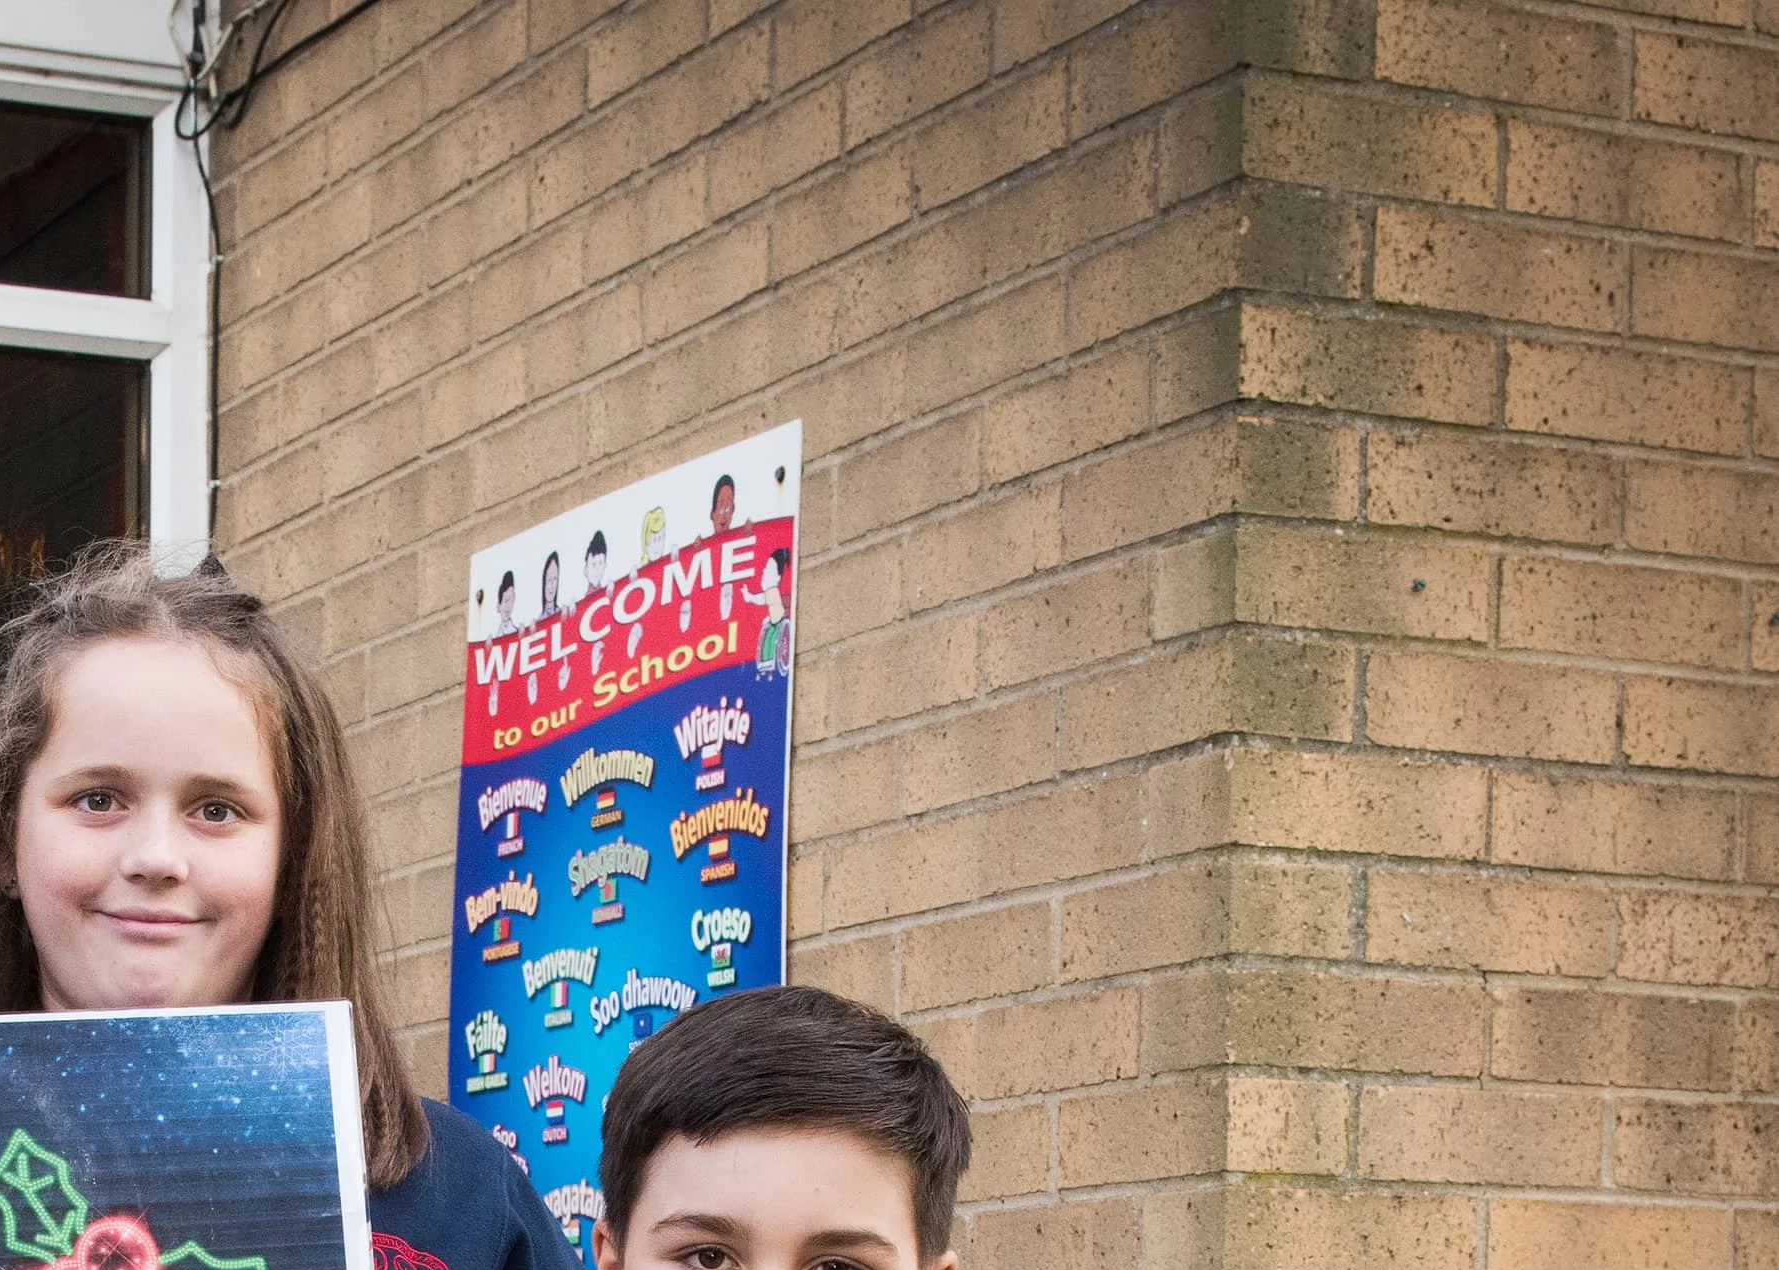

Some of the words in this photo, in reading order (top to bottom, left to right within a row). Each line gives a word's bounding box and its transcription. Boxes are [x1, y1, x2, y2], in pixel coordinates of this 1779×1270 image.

[475, 536, 757, 685] WELCOME
[493, 722, 522, 750] to
[530, 699, 582, 737] our
[593, 621, 739, 709] School
[674, 697, 751, 760] Witajcie
[560, 748, 655, 807] Willkommen
[696, 770, 725, 790] POLISH
[478, 779, 547, 831] Bienvenue
[591, 810, 623, 829] GERMAN
[670, 787, 769, 860] Bienvenidos
[568, 836, 650, 897] Shagatom
[701, 862, 735, 883] SPANISH
[465, 871, 538, 933] Bem-vindo
[692, 907, 752, 951] Croeso
[522, 947, 599, 998] Benvenuti
[707, 968, 736, 987] WELSH
[465, 1010, 508, 1060] Fáilte
[590, 991, 619, 1035] Soo
[523, 1055, 586, 1109] Welkom
[542, 1126, 568, 1144] DUTCH
